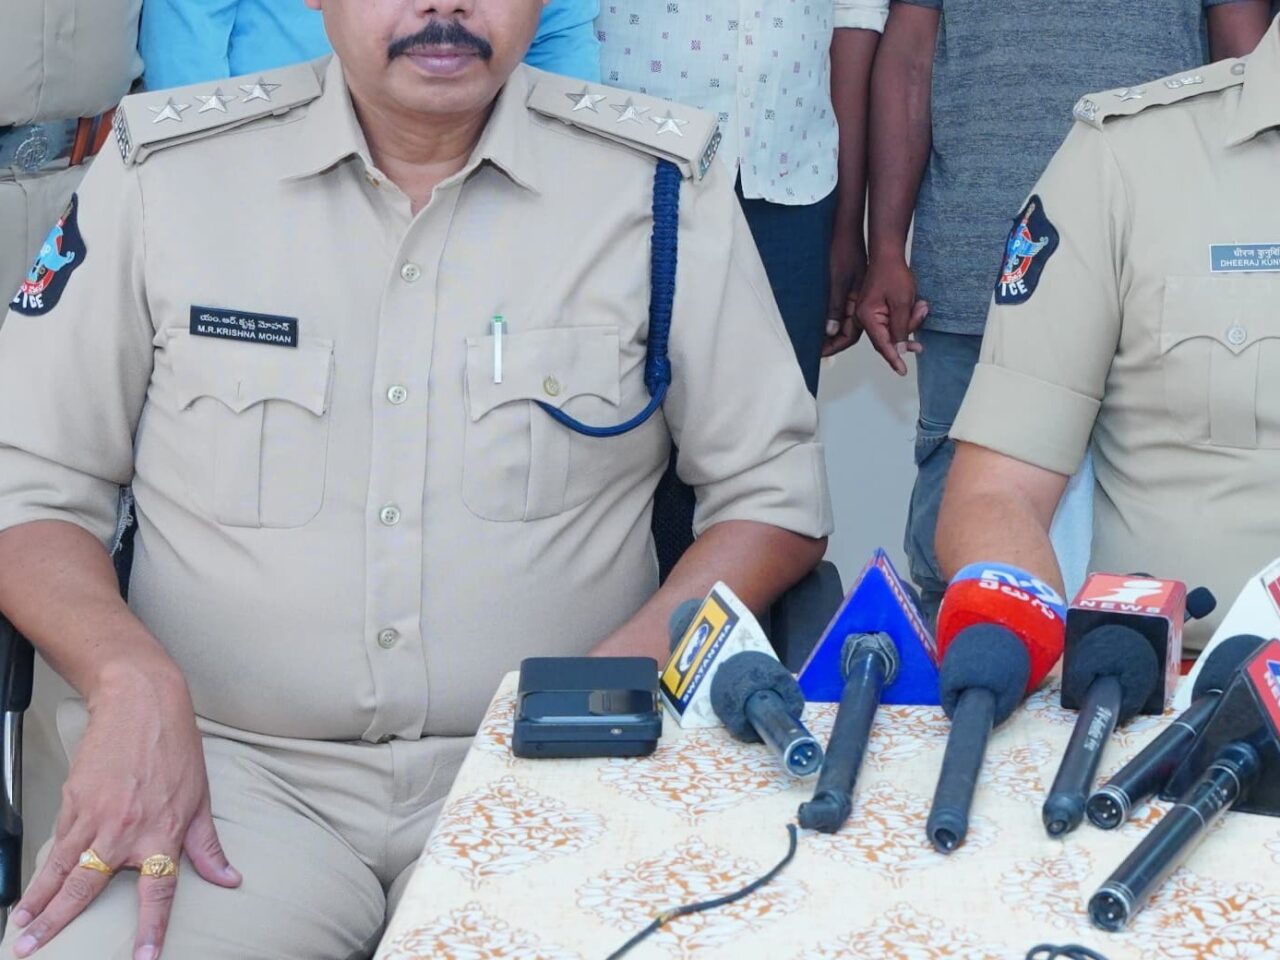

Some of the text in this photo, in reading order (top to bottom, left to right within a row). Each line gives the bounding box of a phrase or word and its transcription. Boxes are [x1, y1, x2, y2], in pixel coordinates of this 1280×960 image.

[1220, 259, 1260, 267] DHEERAJ
[1001, 279, 1028, 297] ICE
[12, 288, 44, 309] LICE
[197, 325, 292, 343] M.R.KRISHNA MOHAN
[1079, 599, 1163, 614] NEWS
[682, 624, 732, 704] SWATANTRA
